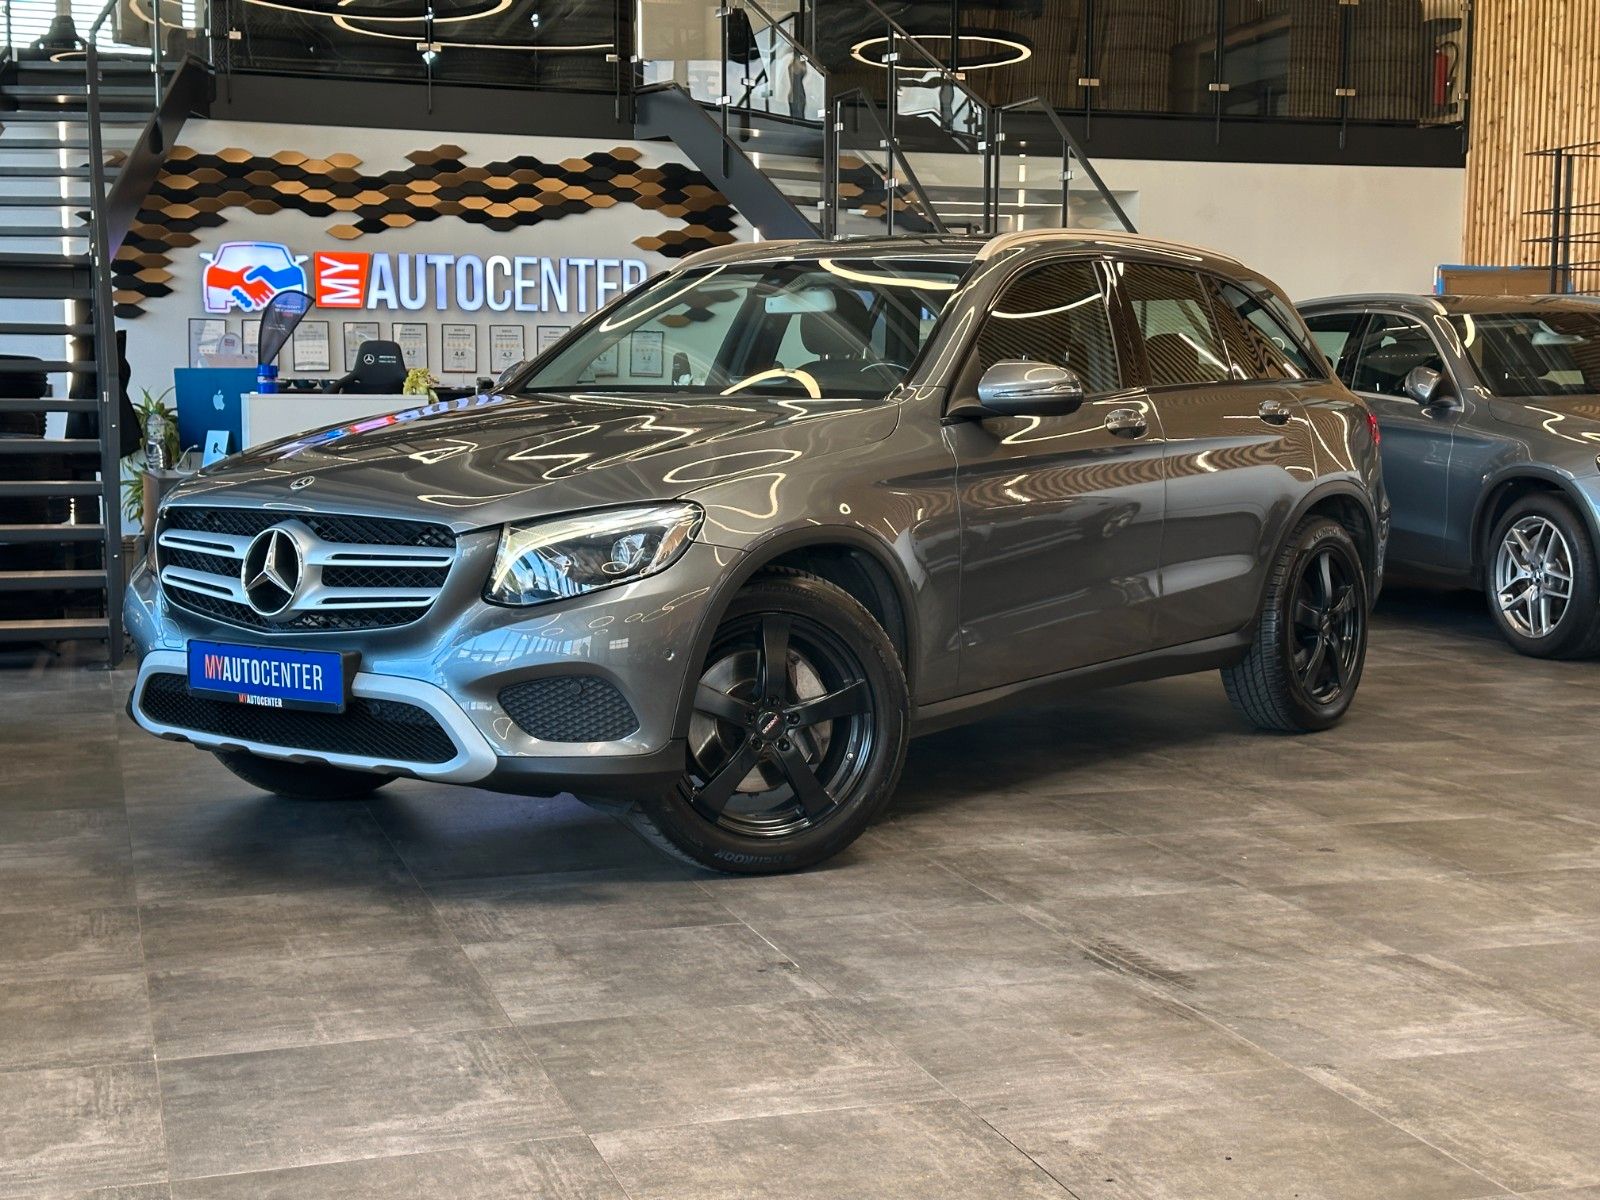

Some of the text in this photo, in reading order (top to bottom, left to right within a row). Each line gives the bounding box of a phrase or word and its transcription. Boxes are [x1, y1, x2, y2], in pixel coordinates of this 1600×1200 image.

[320, 256, 360, 304] MY
[205, 654, 323, 691] MYAUTOCENTER
[238, 693, 283, 708] MYAUTOCENTER
